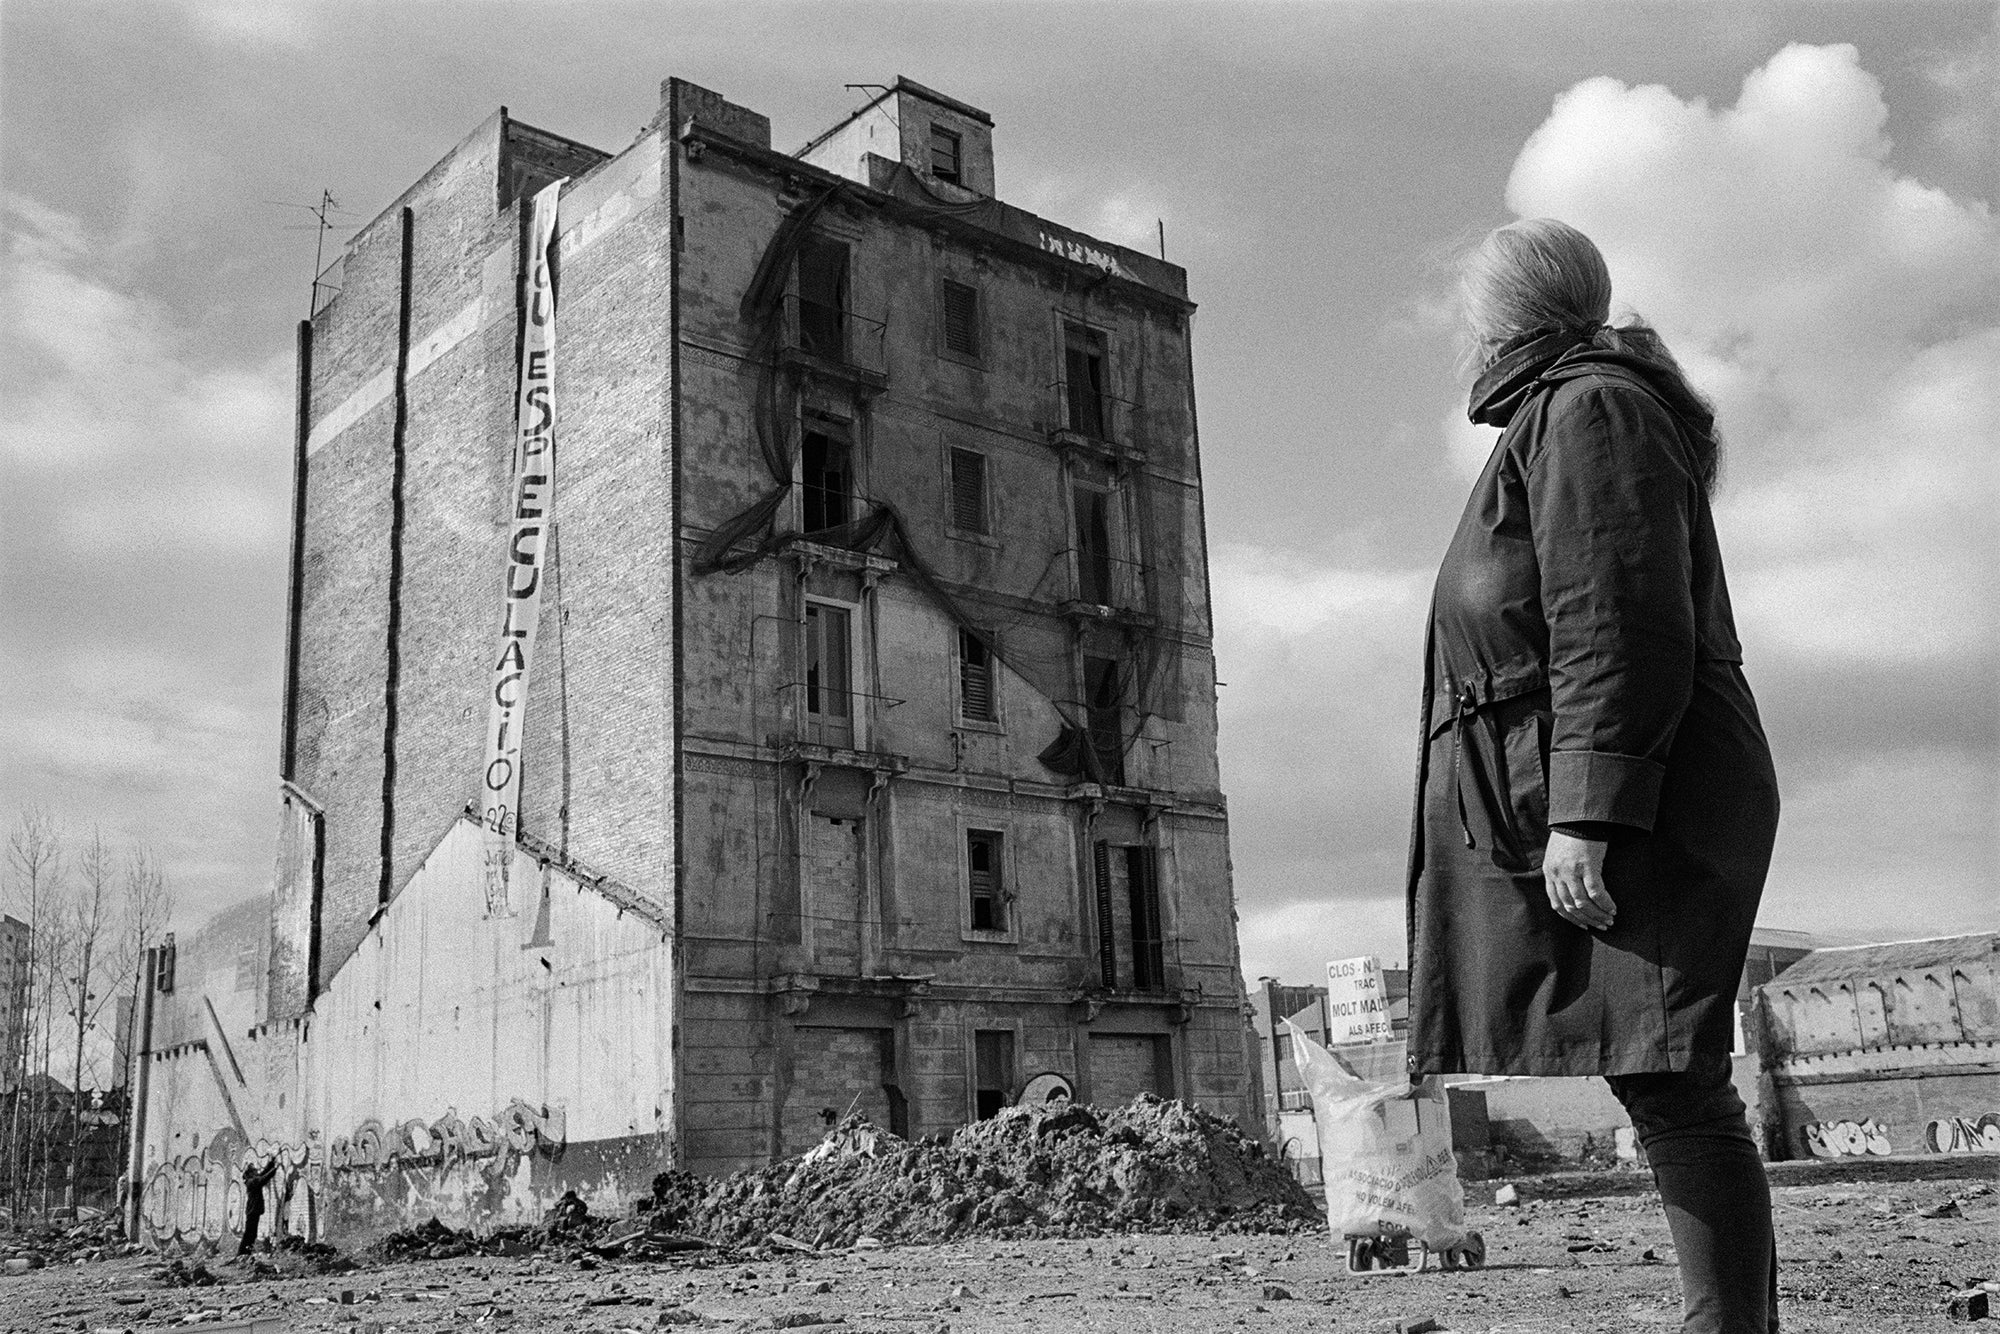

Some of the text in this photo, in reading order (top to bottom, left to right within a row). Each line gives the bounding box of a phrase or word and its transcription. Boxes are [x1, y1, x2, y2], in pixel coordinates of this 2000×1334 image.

[1329, 962, 1355, 979] CLOS
[1332, 1001, 1357, 1018] MOLT
[1348, 1024, 1363, 1037] ALS
[1368, 1193, 1395, 1209] VOLEM
